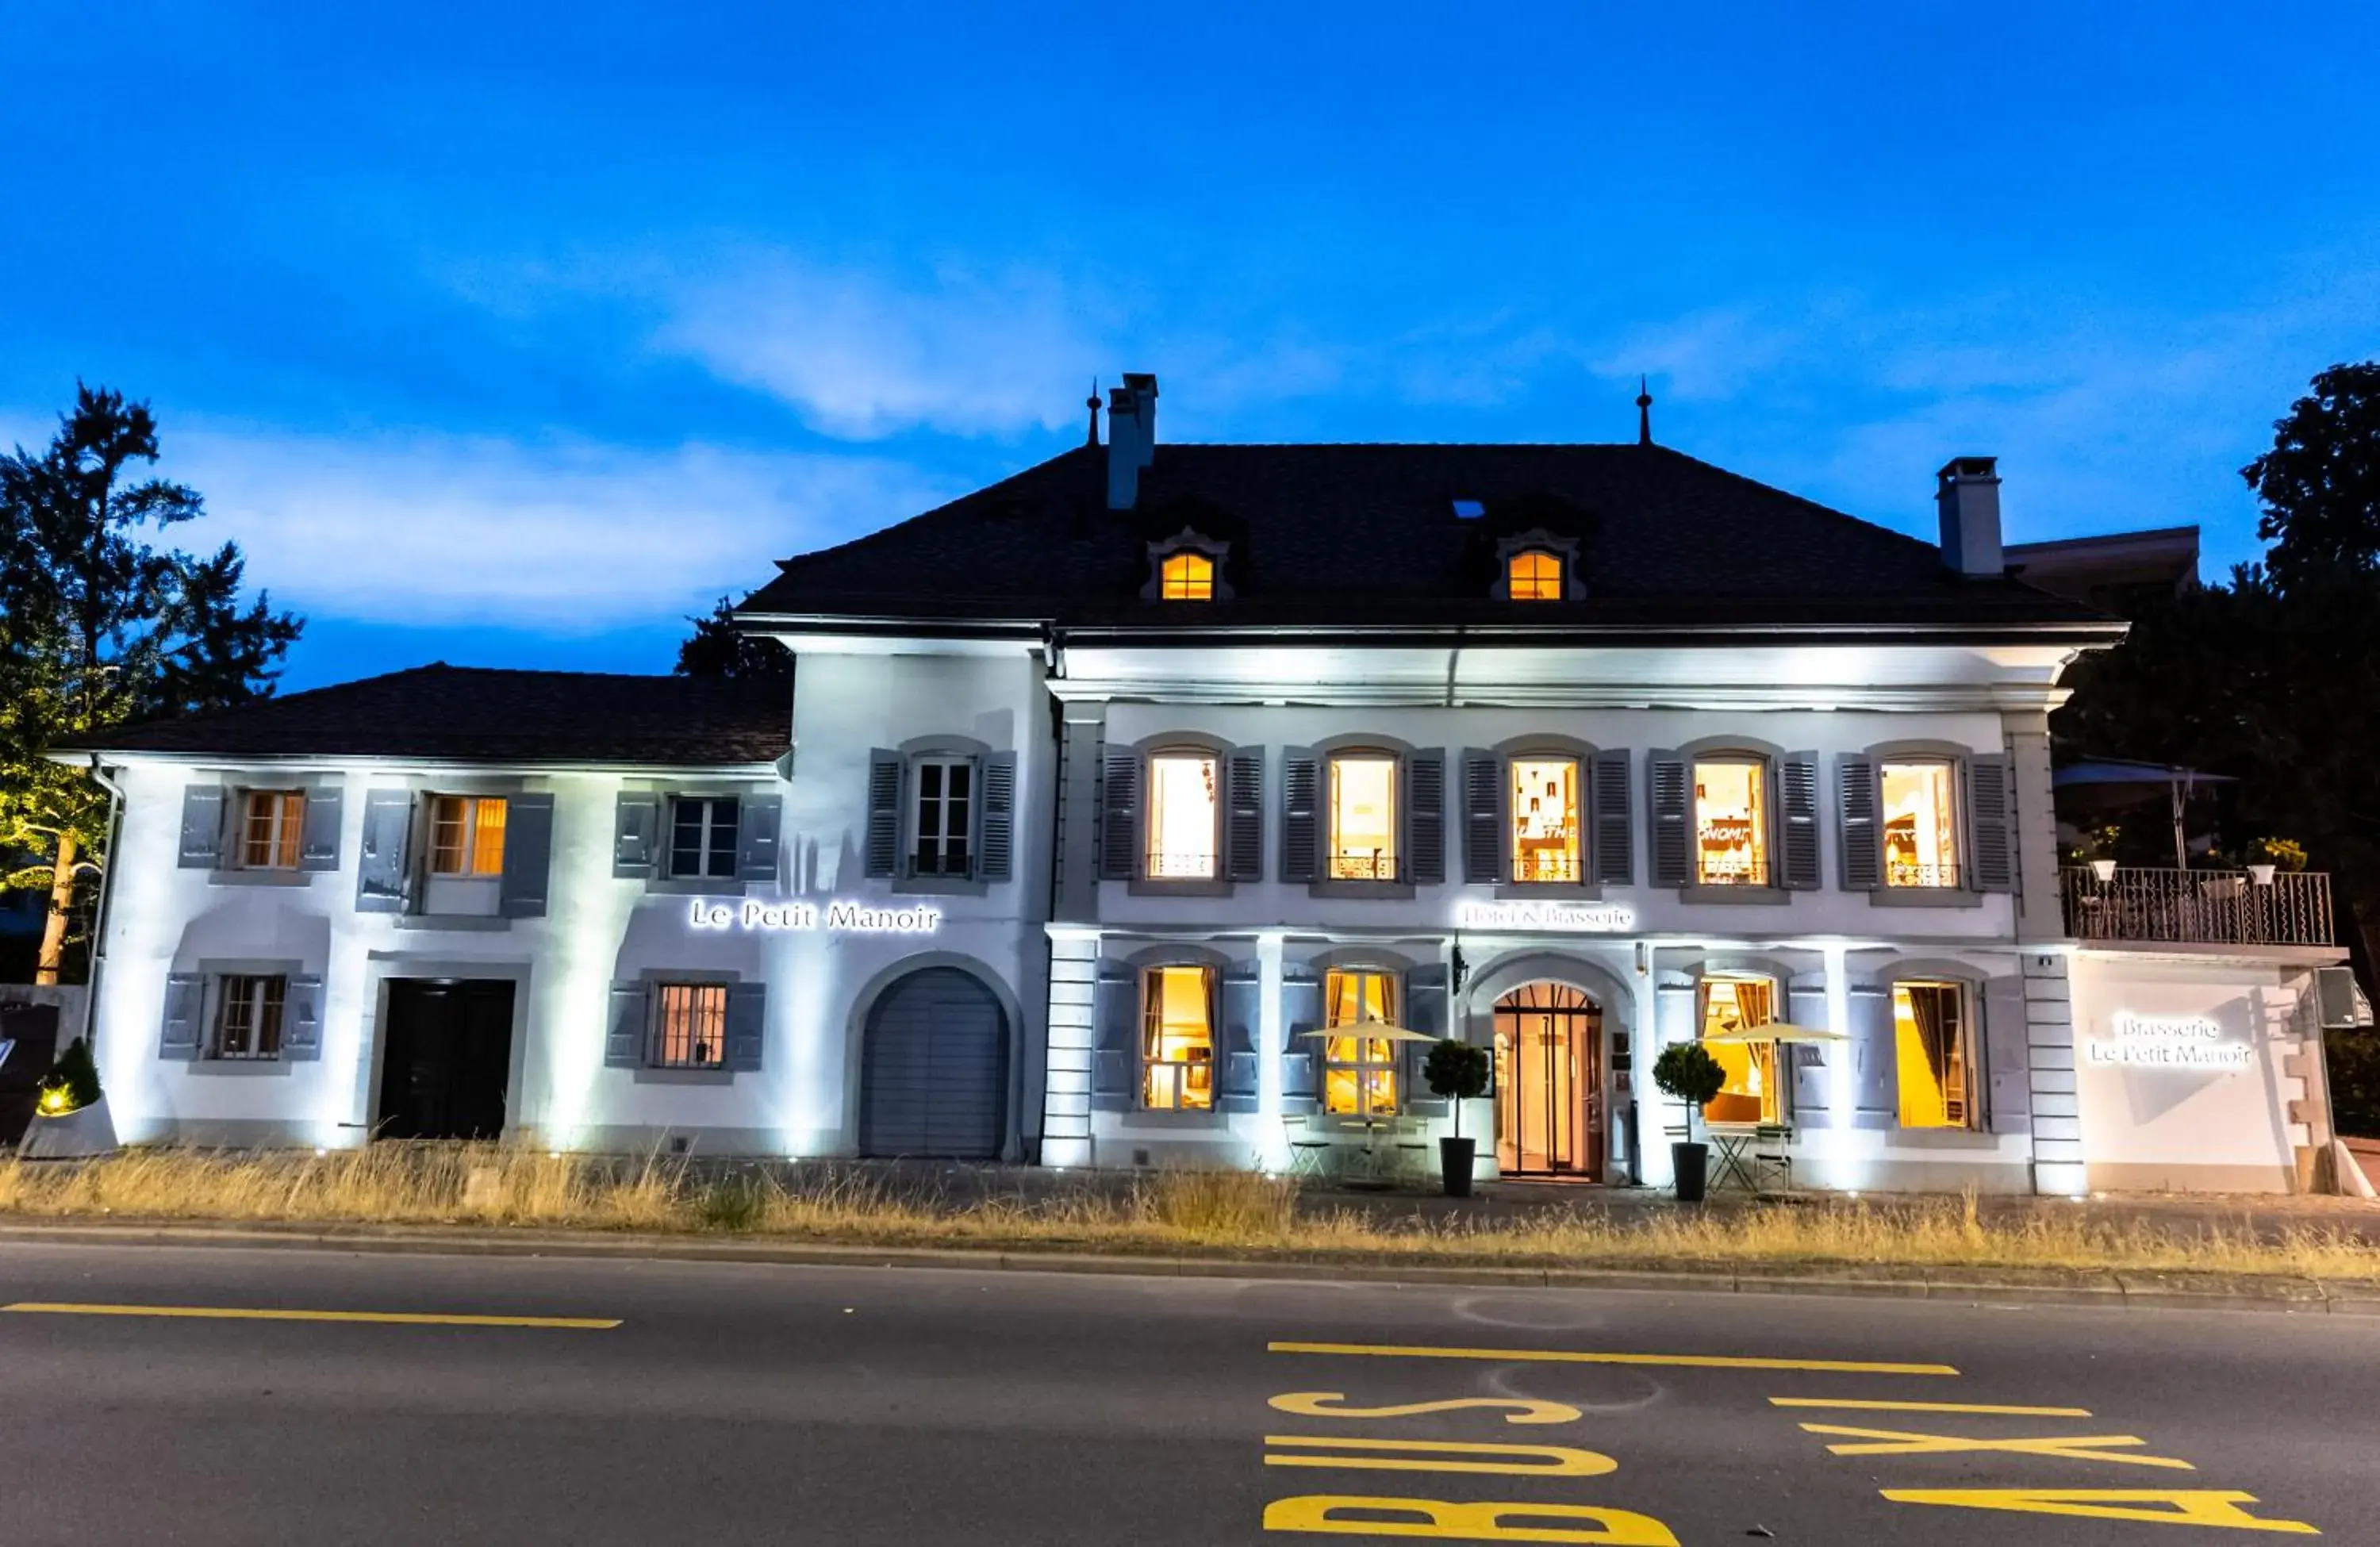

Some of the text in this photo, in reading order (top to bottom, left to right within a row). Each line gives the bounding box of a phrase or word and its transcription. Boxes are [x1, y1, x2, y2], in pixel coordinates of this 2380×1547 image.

[693, 902, 938, 929] Le Petit Manoir
[1546, 908, 1631, 925] Brasserie
[2123, 1019, 2218, 1038] Brasserie
[2091, 1043, 2251, 1064] Le Petit Manoir
[1263, 1392, 1681, 1547] BUS
[1768, 1397, 2324, 1535] AXI
